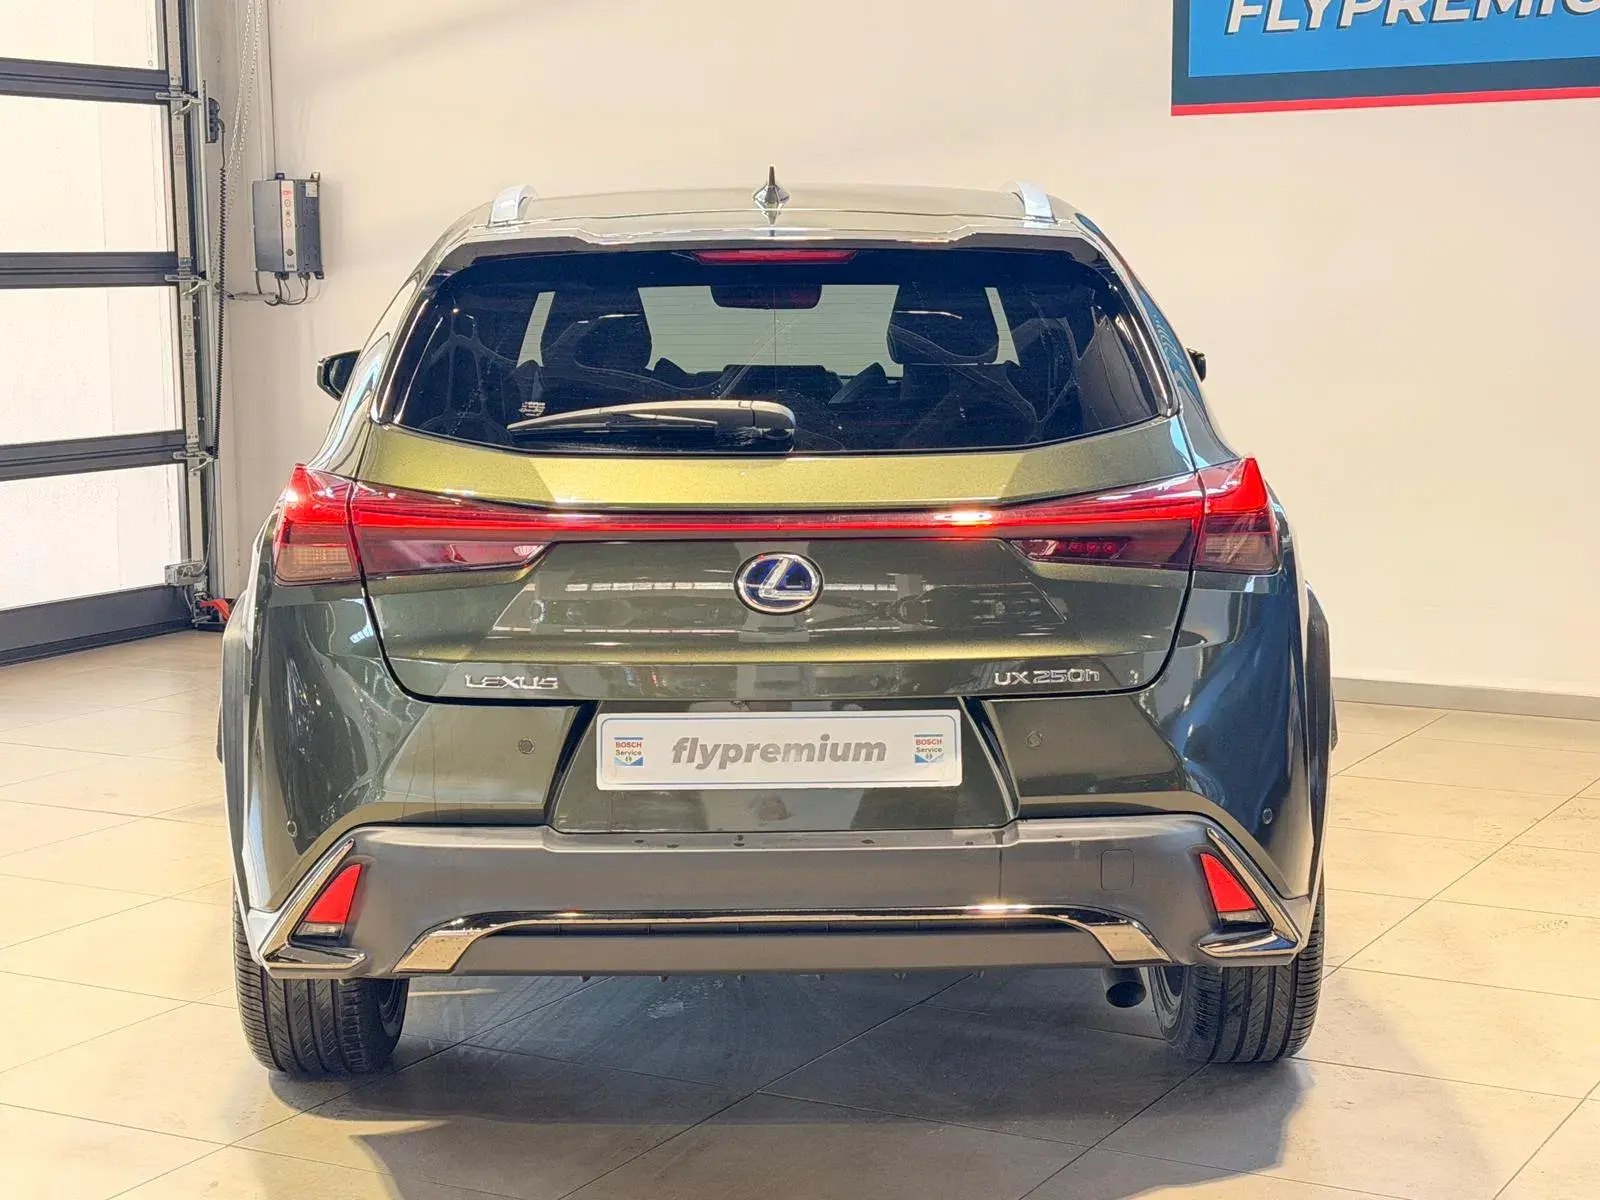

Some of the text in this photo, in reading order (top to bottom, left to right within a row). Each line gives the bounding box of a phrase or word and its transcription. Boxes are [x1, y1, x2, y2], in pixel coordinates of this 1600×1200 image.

[1225, 0, 1600, 35] FLYPR
[464, 674, 559, 690] LEXUS
[994, 668, 1100, 686] UX 250h
[915, 738, 942, 746] BOSCH
[671, 733, 888, 770] flypremium
